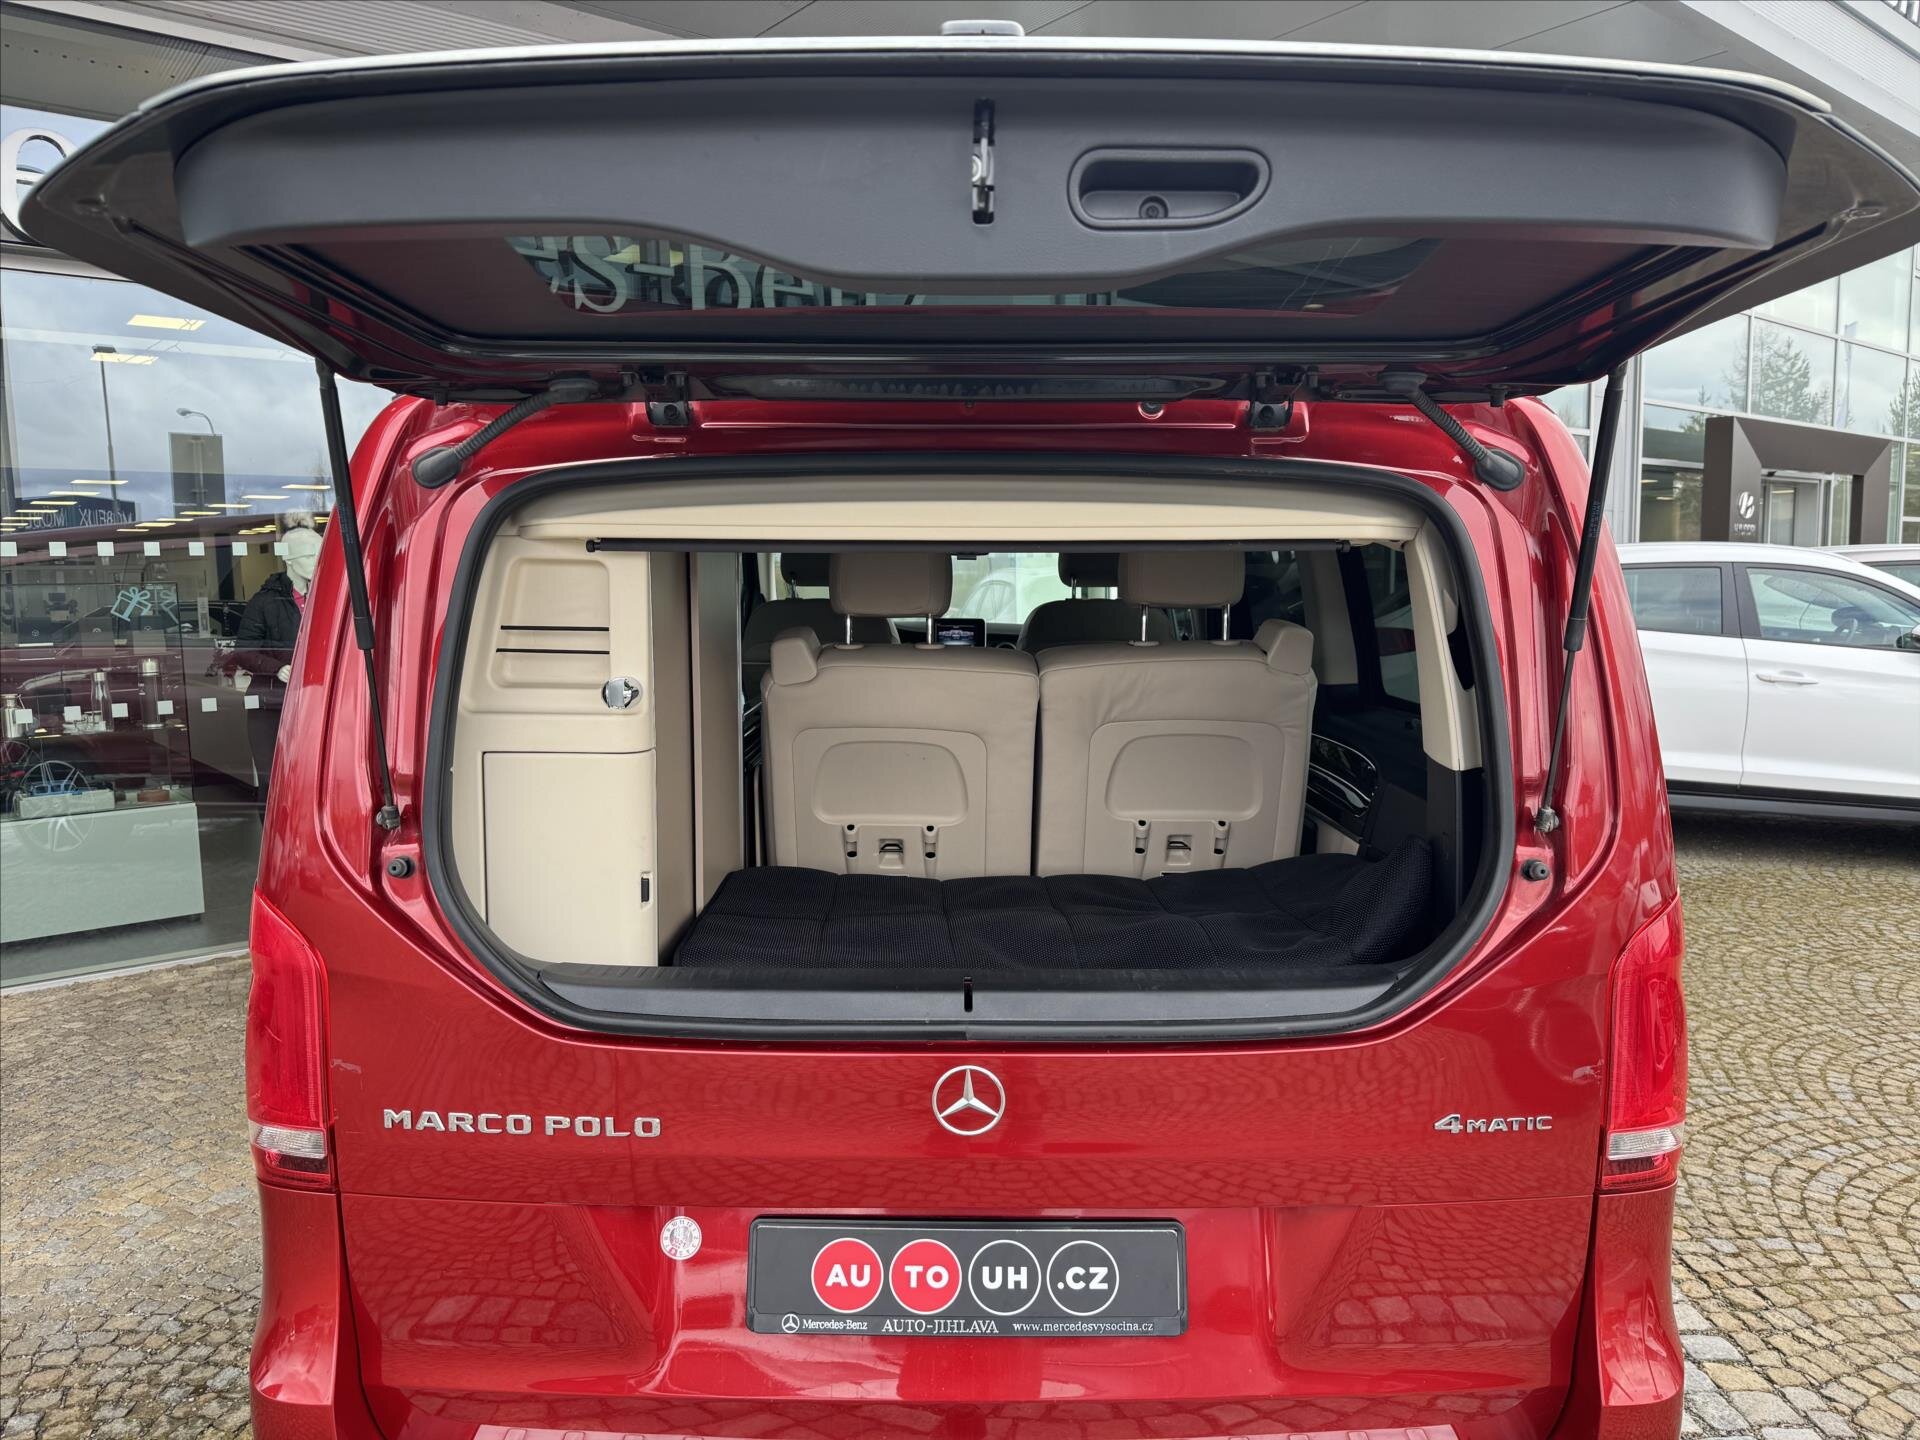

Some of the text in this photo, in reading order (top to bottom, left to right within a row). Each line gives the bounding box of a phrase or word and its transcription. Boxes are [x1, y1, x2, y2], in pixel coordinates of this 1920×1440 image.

[383, 1109, 661, 1138] MARCO POLO
[1434, 1114, 1553, 1134] 4MATIC
[825, 1264, 1109, 1290] AU TO UH .CZ
[802, 1318, 1154, 1334] Mercedes-Benz AUTO-JIHLAVA www.mercedesvysocina.cz
